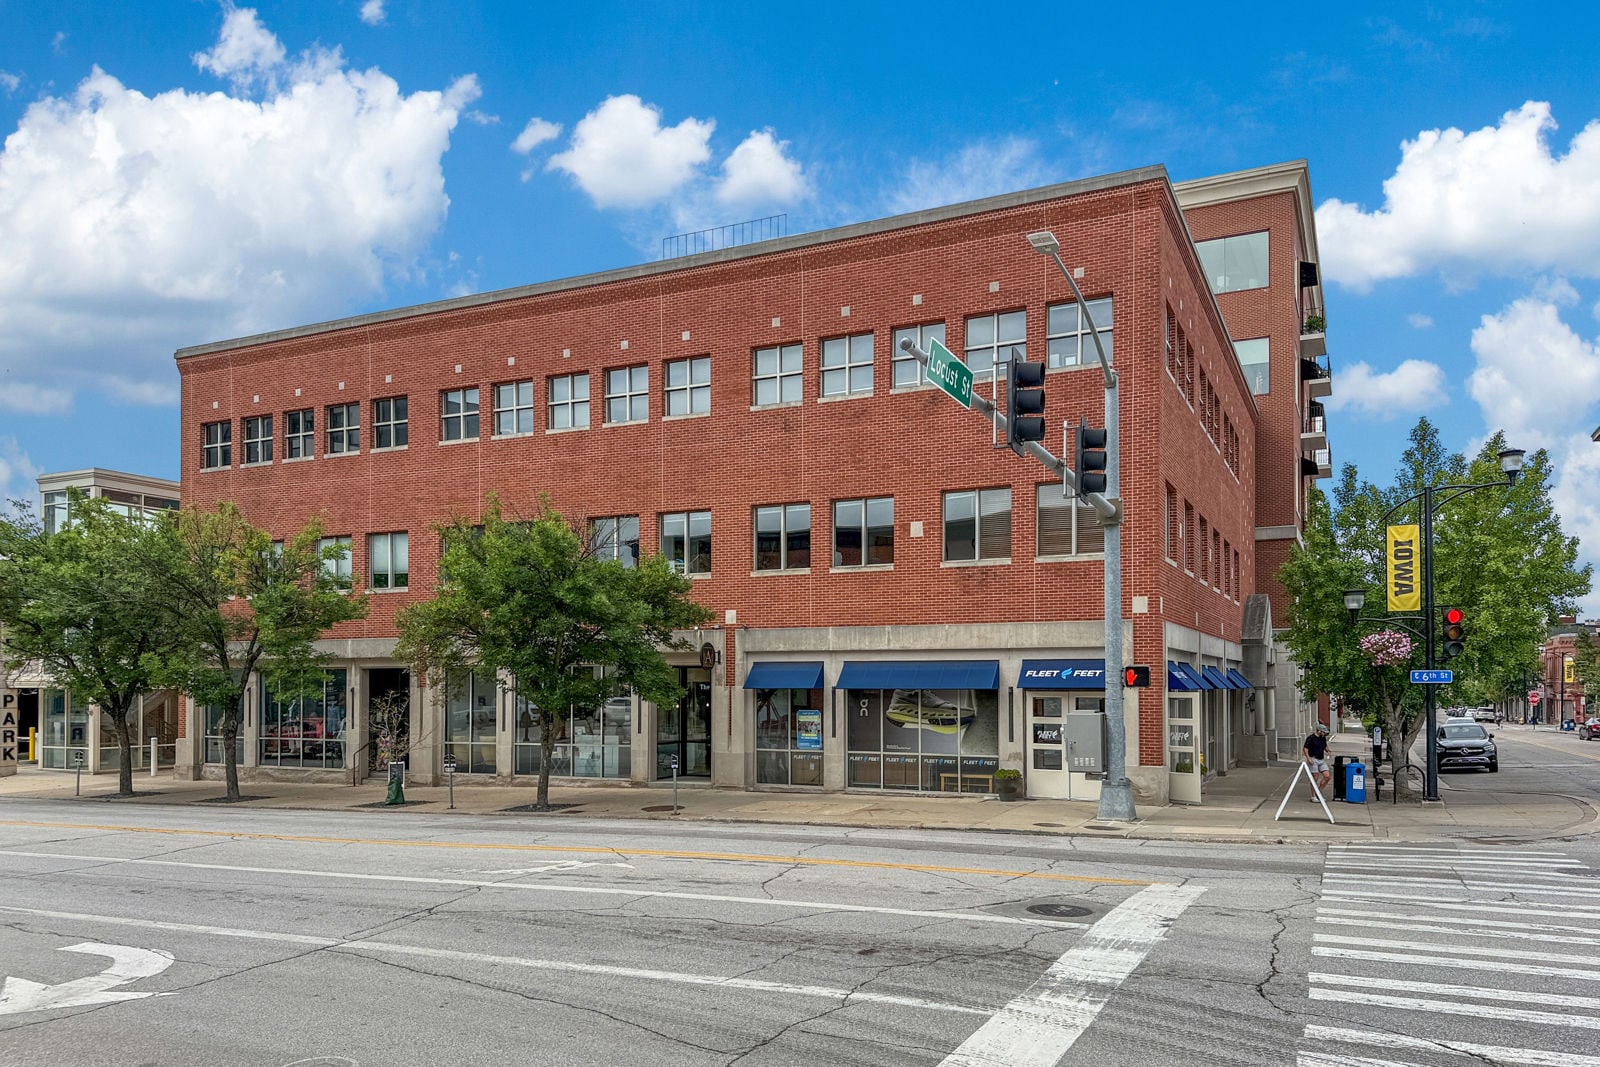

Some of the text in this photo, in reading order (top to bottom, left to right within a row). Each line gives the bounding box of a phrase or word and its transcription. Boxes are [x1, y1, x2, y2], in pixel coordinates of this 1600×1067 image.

[931, 351, 970, 398] Locust St
[1394, 539, 1413, 597] IOWA
[1422, 672, 1437, 681] 6th
[3, 694, 15, 760] PARK
